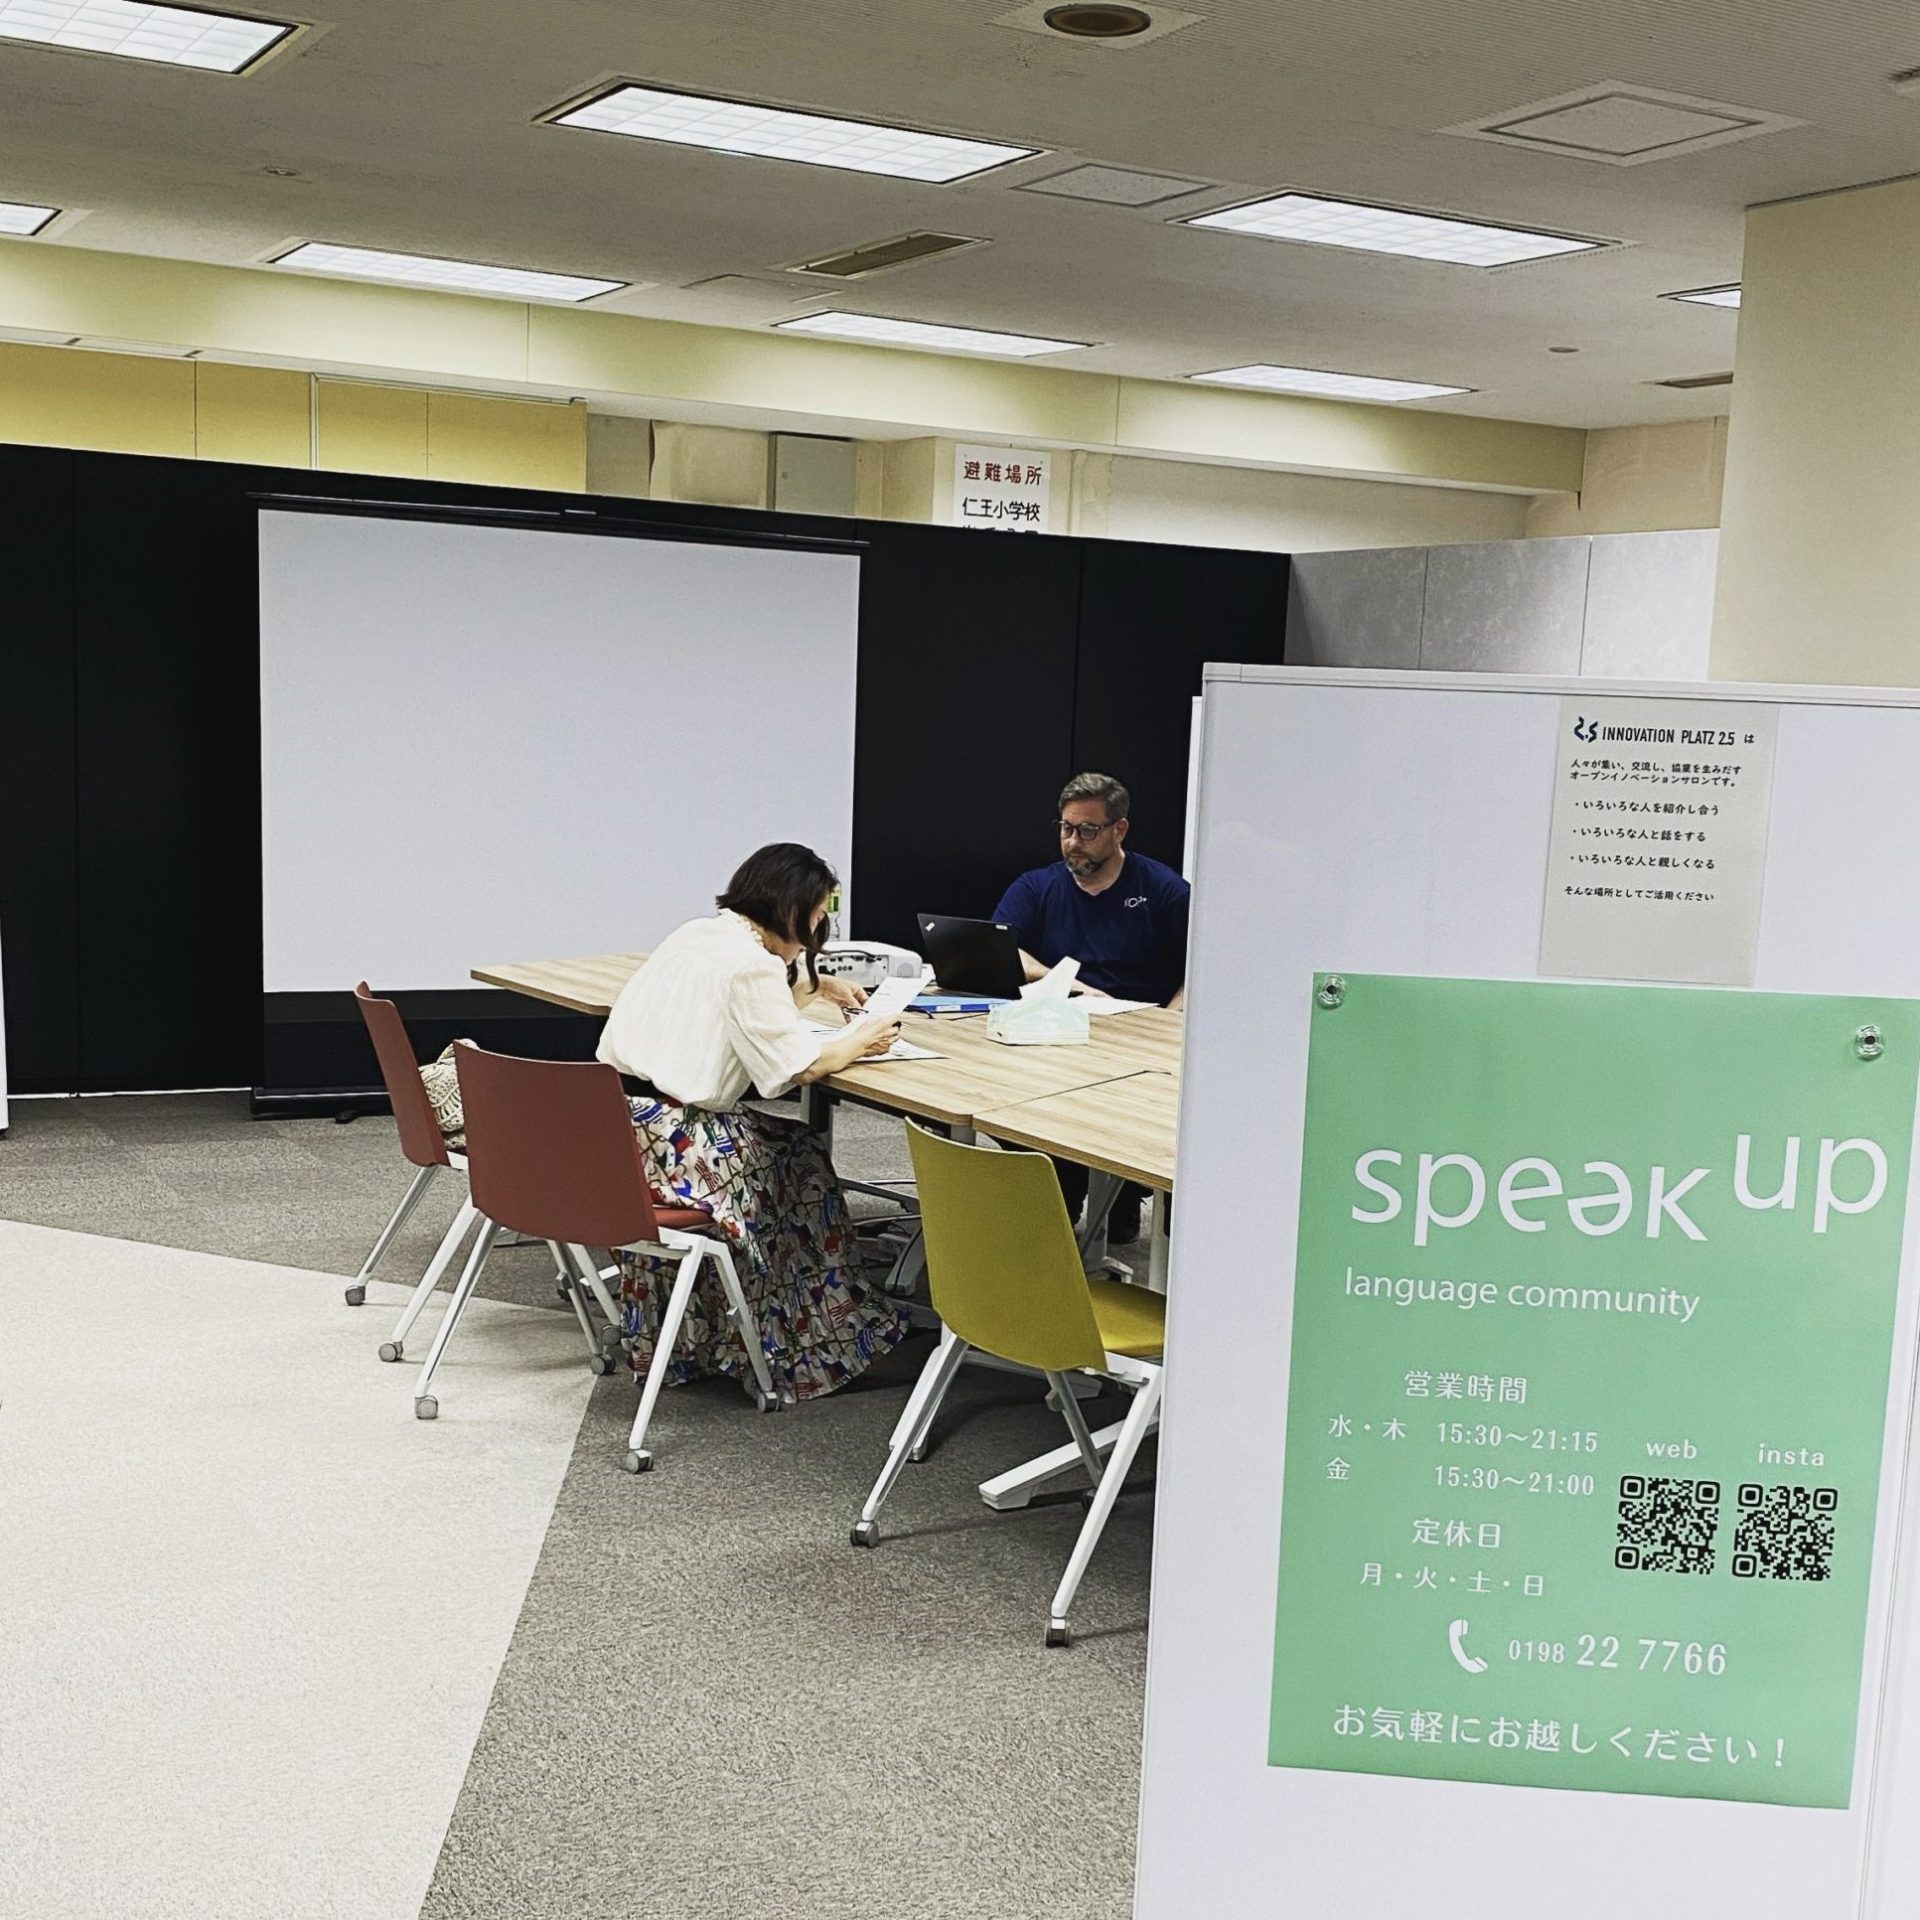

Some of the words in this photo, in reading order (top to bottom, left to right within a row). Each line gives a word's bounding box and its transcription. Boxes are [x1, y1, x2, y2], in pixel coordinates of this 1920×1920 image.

[963, 461, 1042, 486] 避難場所
[962, 497, 1041, 522] 仁王小学校
[1602, 726, 1675, 743] INNOVATION
[1681, 730, 1715, 745] PLATZ
[1718, 732, 1736, 746] 2.5
[1744, 734, 1755, 744] は
[1564, 886, 1714, 901] そんな場所としてご活用ください
[1733, 1134, 1888, 1233] up
[1345, 1267, 1498, 1310] language
[1507, 1280, 1700, 1322] community
[1404, 1370, 1527, 1404] 営業時間
[1327, 1414, 1406, 1442] 水・木
[1645, 1439, 1698, 1460] web
[1757, 1443, 1826, 1468] insta
[1325, 1456, 1351, 1482] 金
[1411, 1517, 1501, 1549] 定休日
[1359, 1561, 1544, 1596] 月・火・土・日
[1507, 1639, 1565, 1664] 0198
[1576, 1633, 1619, 1668] 22
[1638, 1637, 1728, 1676] 7766
[1333, 1704, 1786, 1768] お気軽にお越しください！
